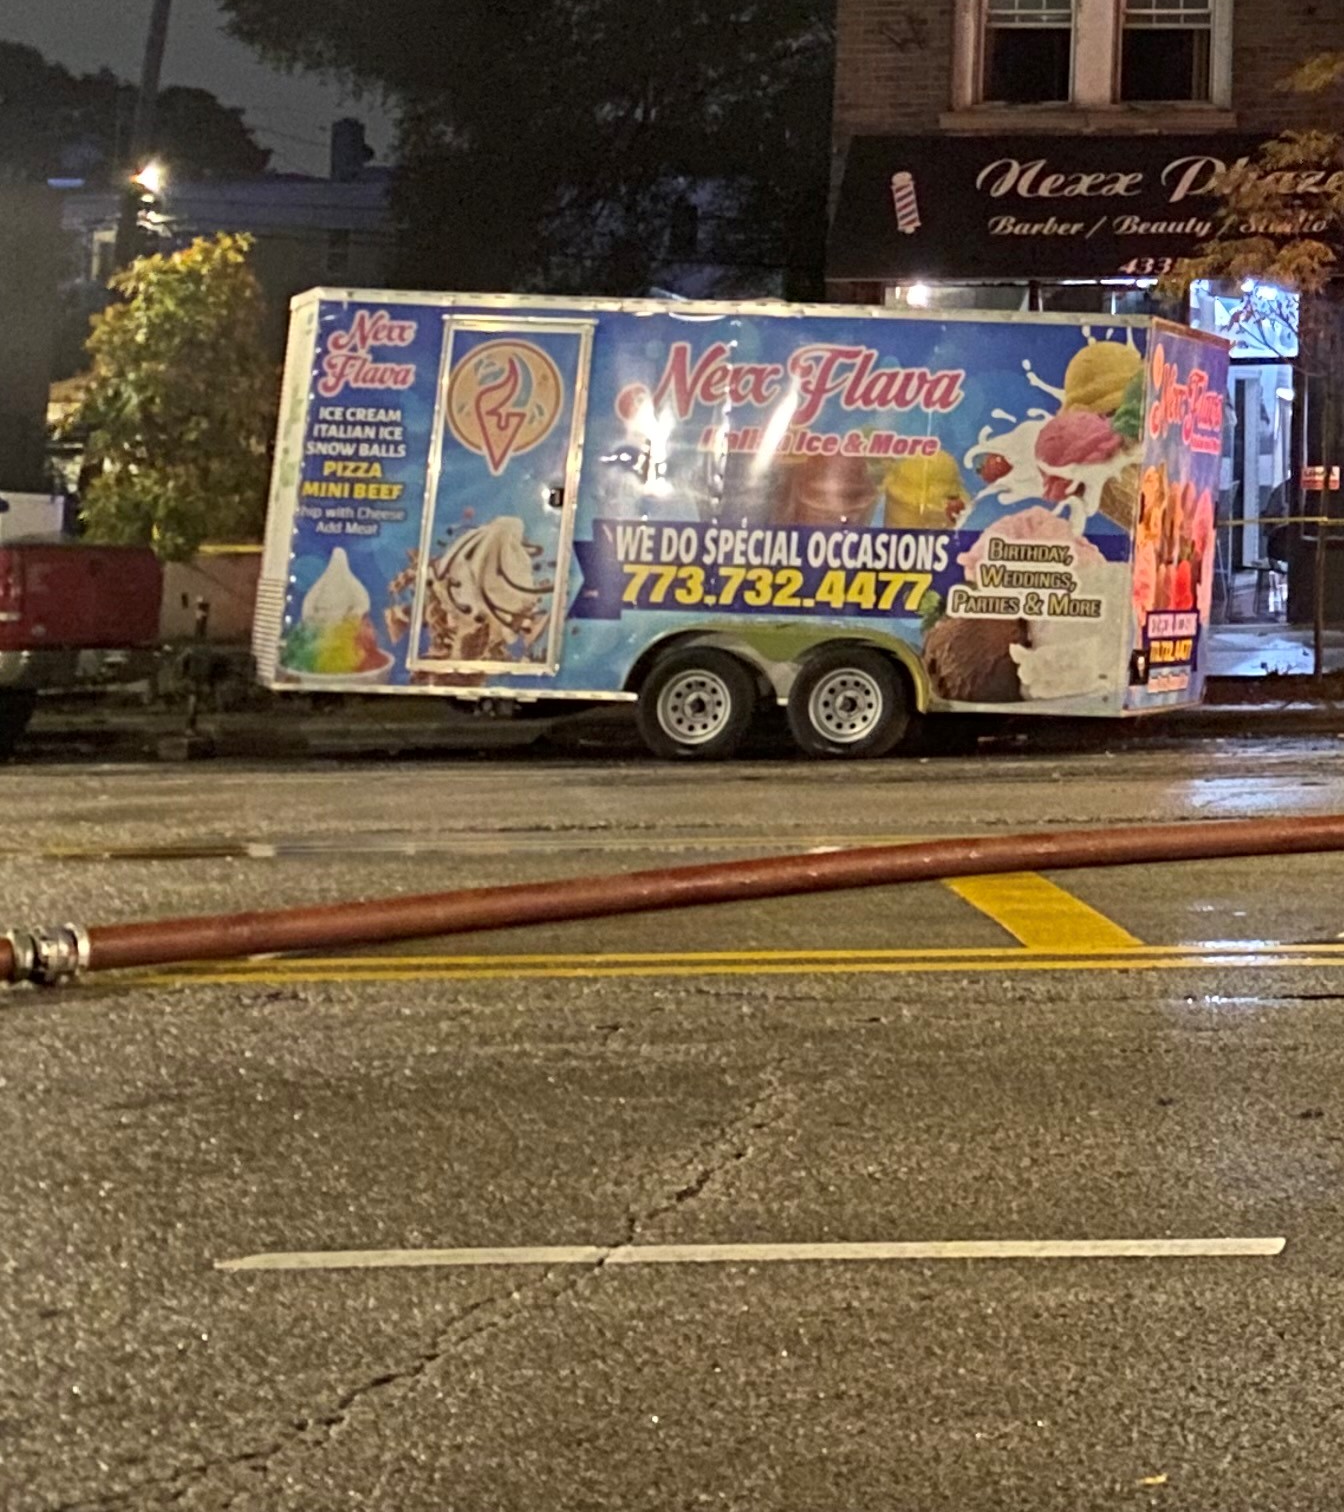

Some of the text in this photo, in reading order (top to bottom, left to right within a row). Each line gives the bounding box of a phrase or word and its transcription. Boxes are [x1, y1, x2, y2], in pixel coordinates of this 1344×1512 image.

[976, 158, 1143, 199] Nexx
[988, 214, 1085, 237] Barber
[1112, 214, 1212, 239] Beauty
[329, 310, 417, 351] Nexx
[319, 353, 416, 396] Flava
[615, 343, 965, 428] Nexx Flava
[319, 406, 402, 422] ICE CREAM
[313, 423, 404, 441] ITALIAN ICE
[795, 430, 842, 456] Ice
[841, 431, 868, 456] &
[868, 431, 941, 457] More
[306, 441, 408, 458] SNOW BALLS
[323, 460, 383, 478] PIZZA
[302, 480, 405, 500] MINI BEEF
[325, 506, 355, 520] with
[616, 525, 950, 572] WE DO SPECIAL OCCASIONS
[622, 563, 933, 611] 773.732.4477
[1023, 592, 1045, 616] &
